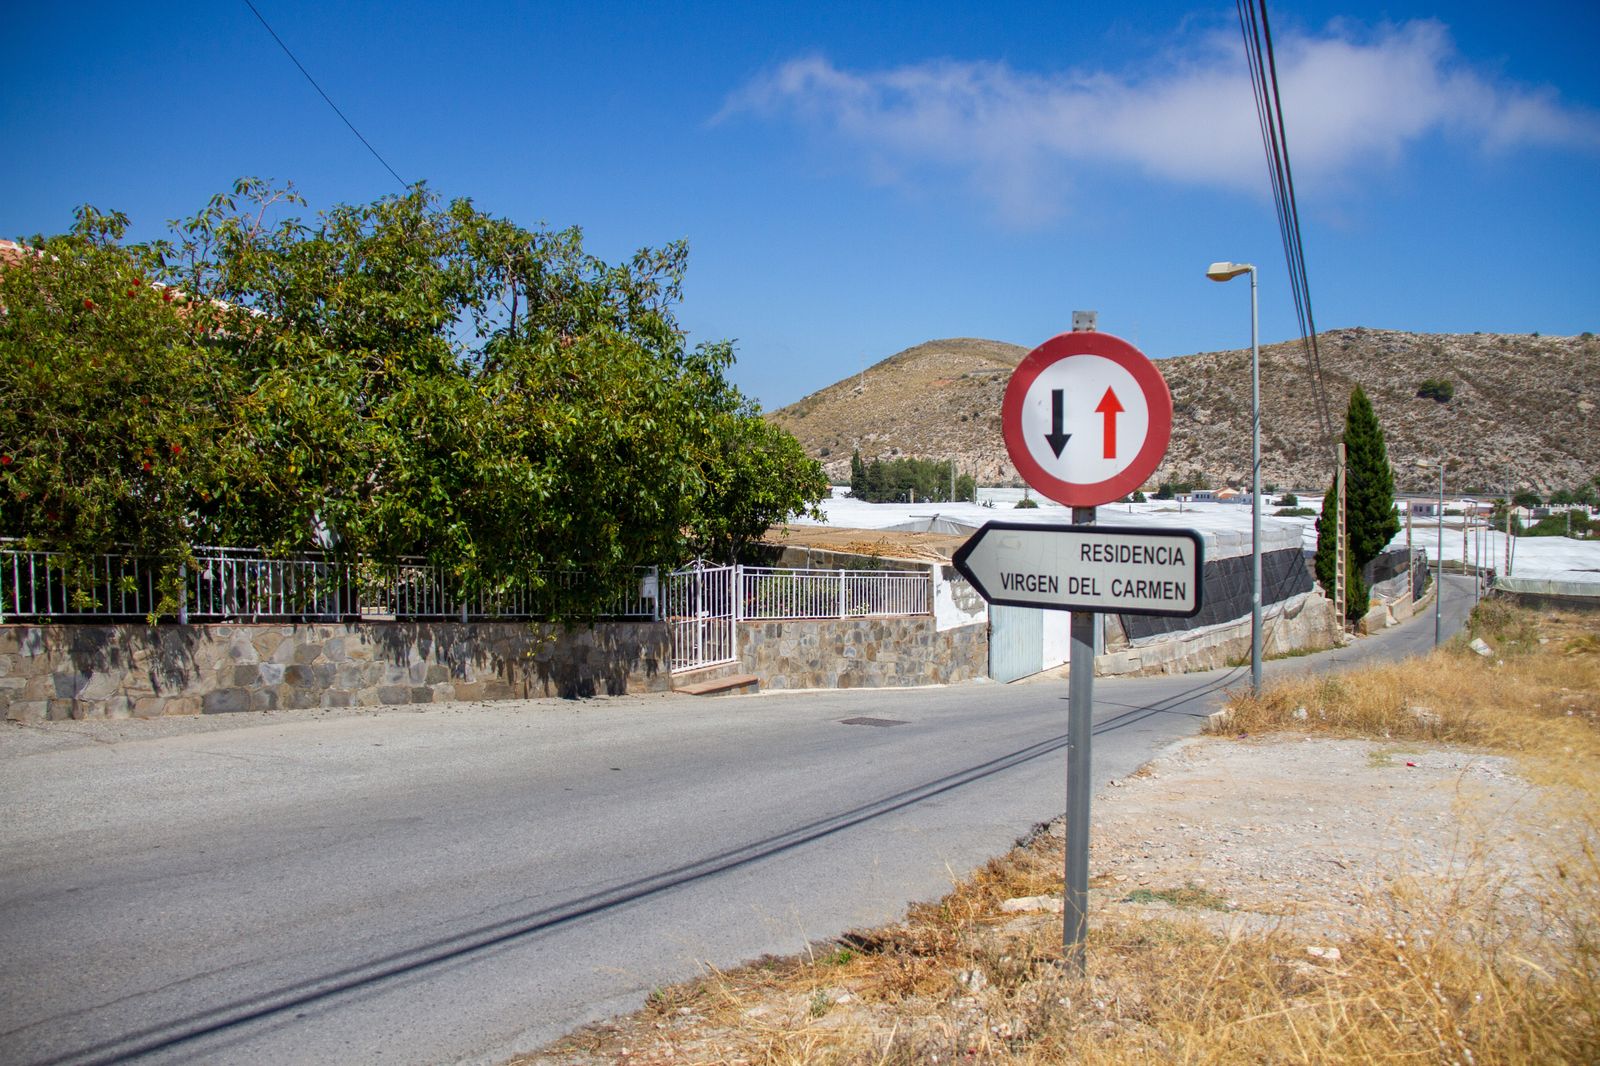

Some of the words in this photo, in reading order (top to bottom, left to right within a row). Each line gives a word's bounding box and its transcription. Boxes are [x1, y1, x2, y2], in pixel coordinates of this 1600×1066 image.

[1080, 543, 1185, 566] RESIDENCIA
[1000, 572, 1059, 593] VIRGEN
[1069, 577, 1101, 596] DEL
[1111, 579, 1186, 600] CARMEN
